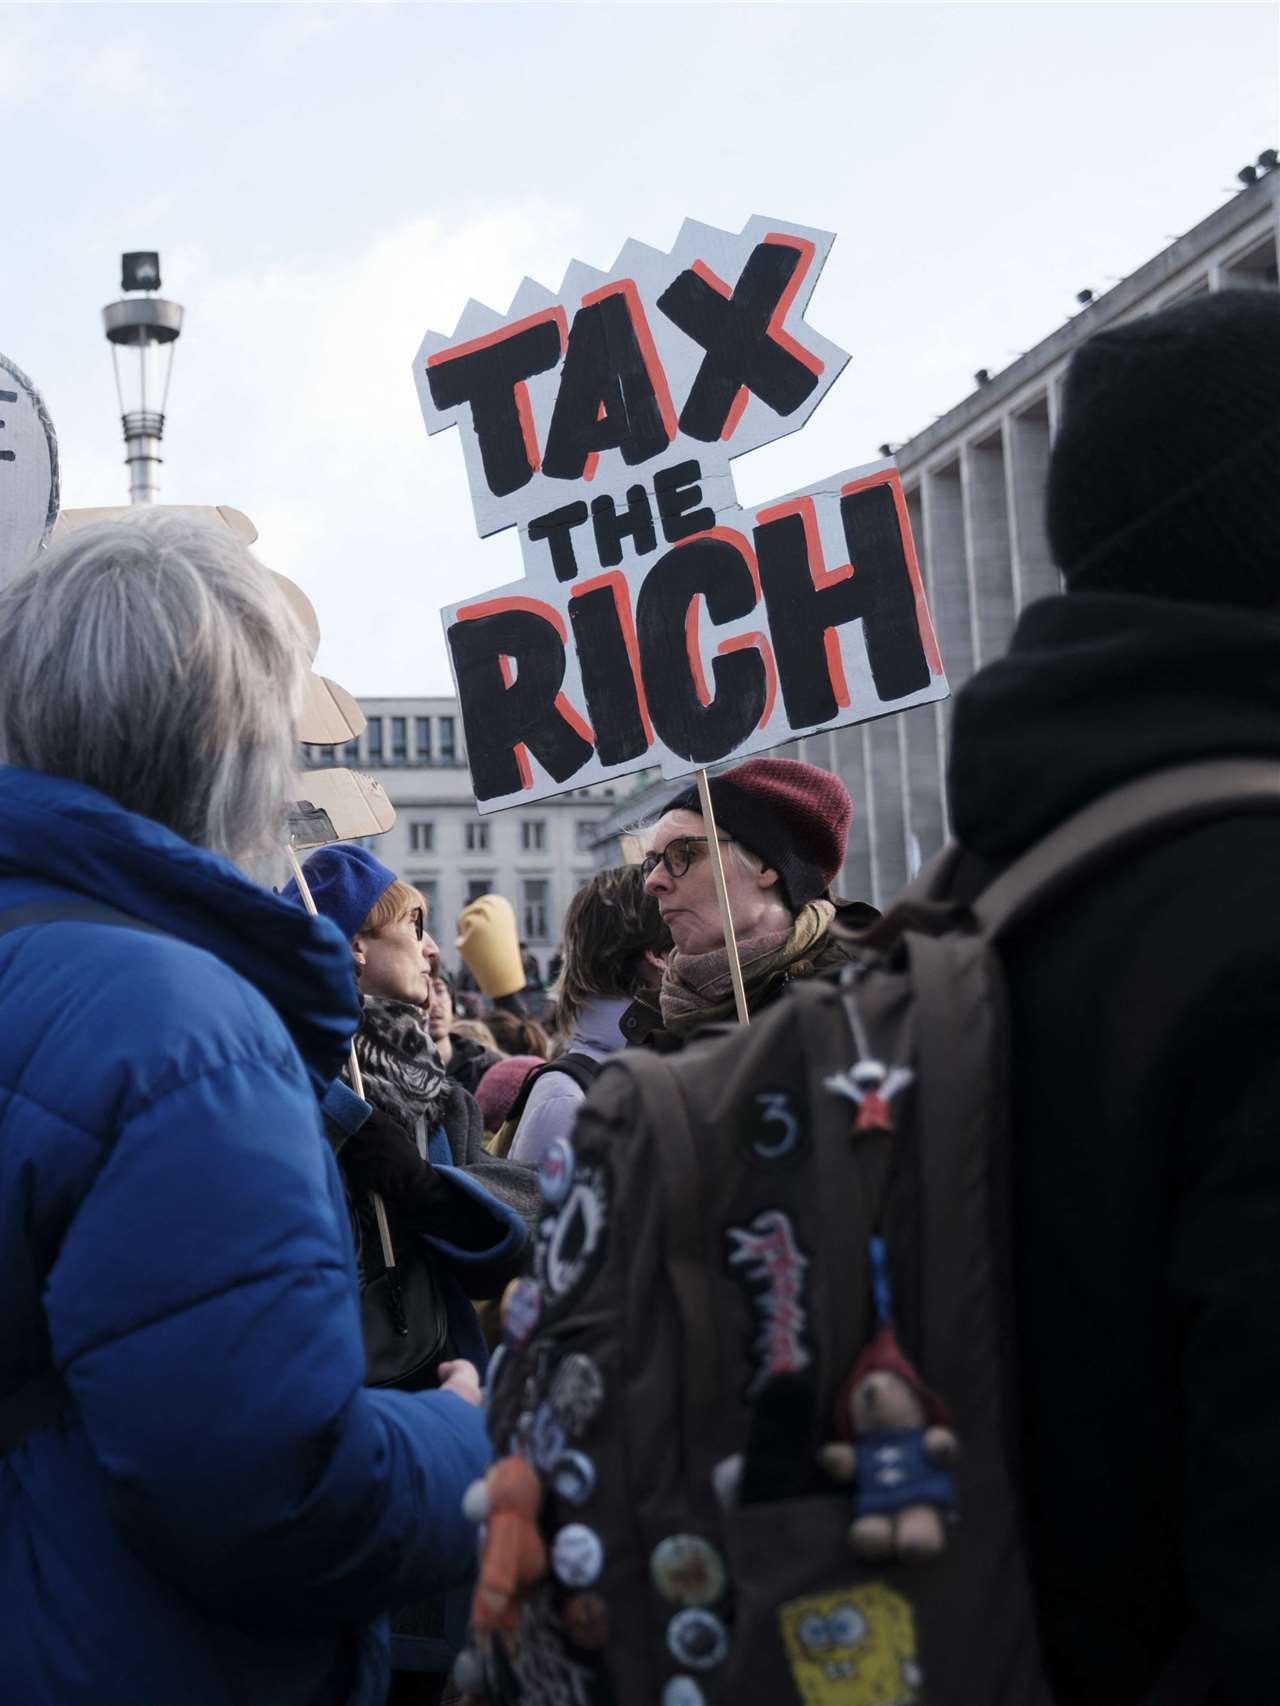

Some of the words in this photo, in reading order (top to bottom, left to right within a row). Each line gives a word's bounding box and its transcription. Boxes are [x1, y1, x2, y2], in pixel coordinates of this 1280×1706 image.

[425, 232, 825, 498] TAX
[446, 467, 945, 804] RICH
[527, 459, 717, 584] THE
